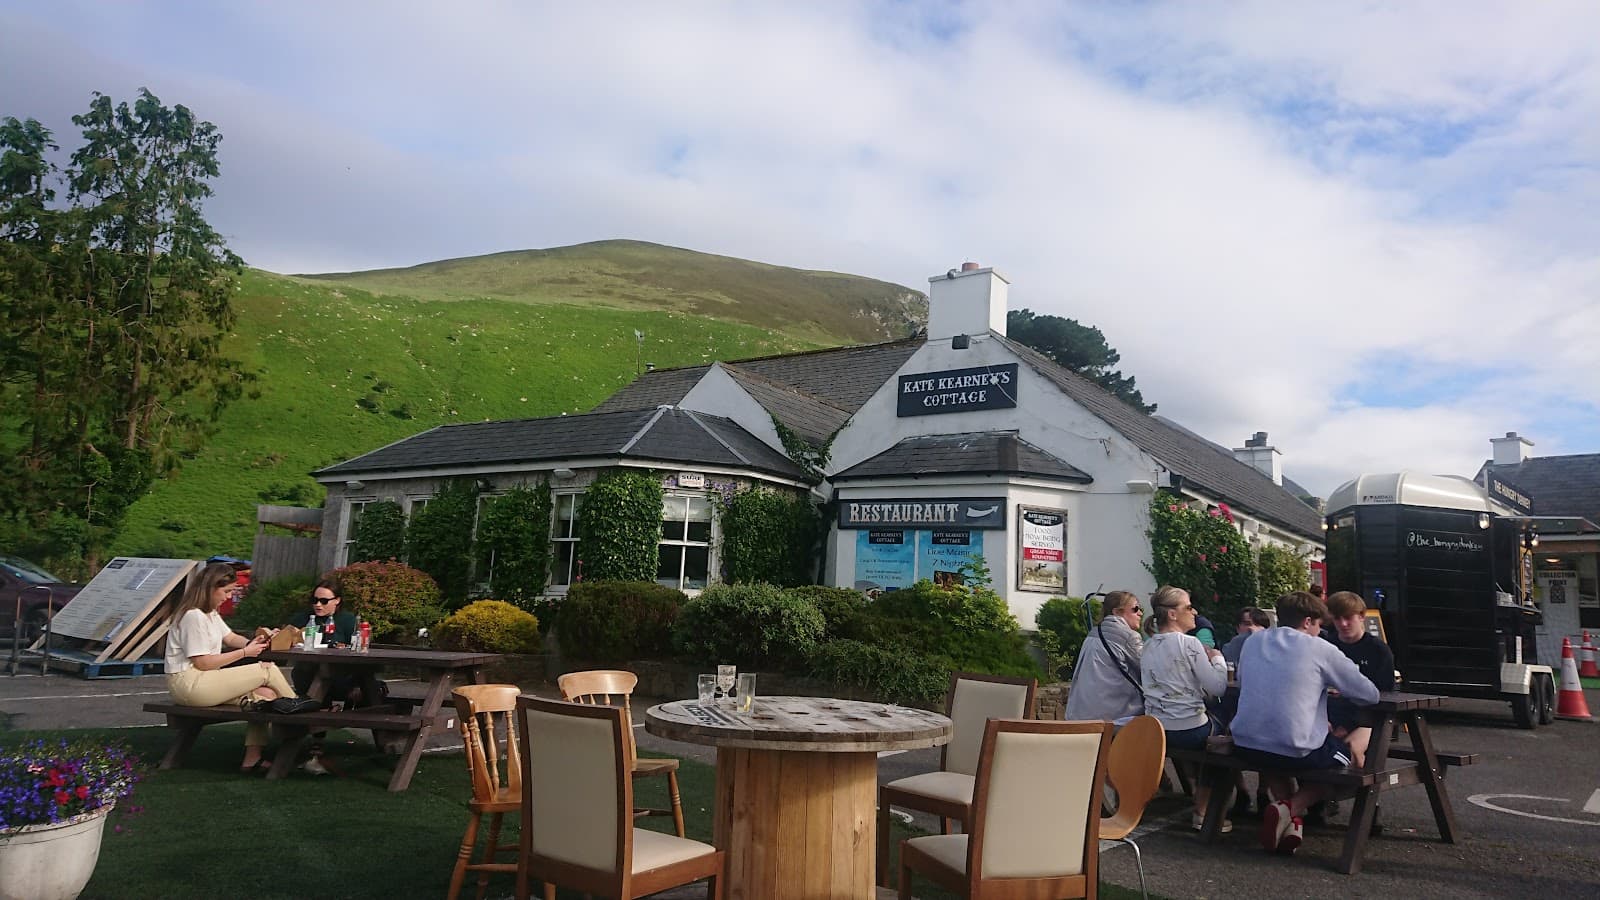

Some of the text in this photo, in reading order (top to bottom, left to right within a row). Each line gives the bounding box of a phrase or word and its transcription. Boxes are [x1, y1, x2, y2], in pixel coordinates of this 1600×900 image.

[903, 379, 935, 393] KATE
[923, 390, 987, 407] COTTAGE
[850, 503, 959, 522] RESTAURANT
